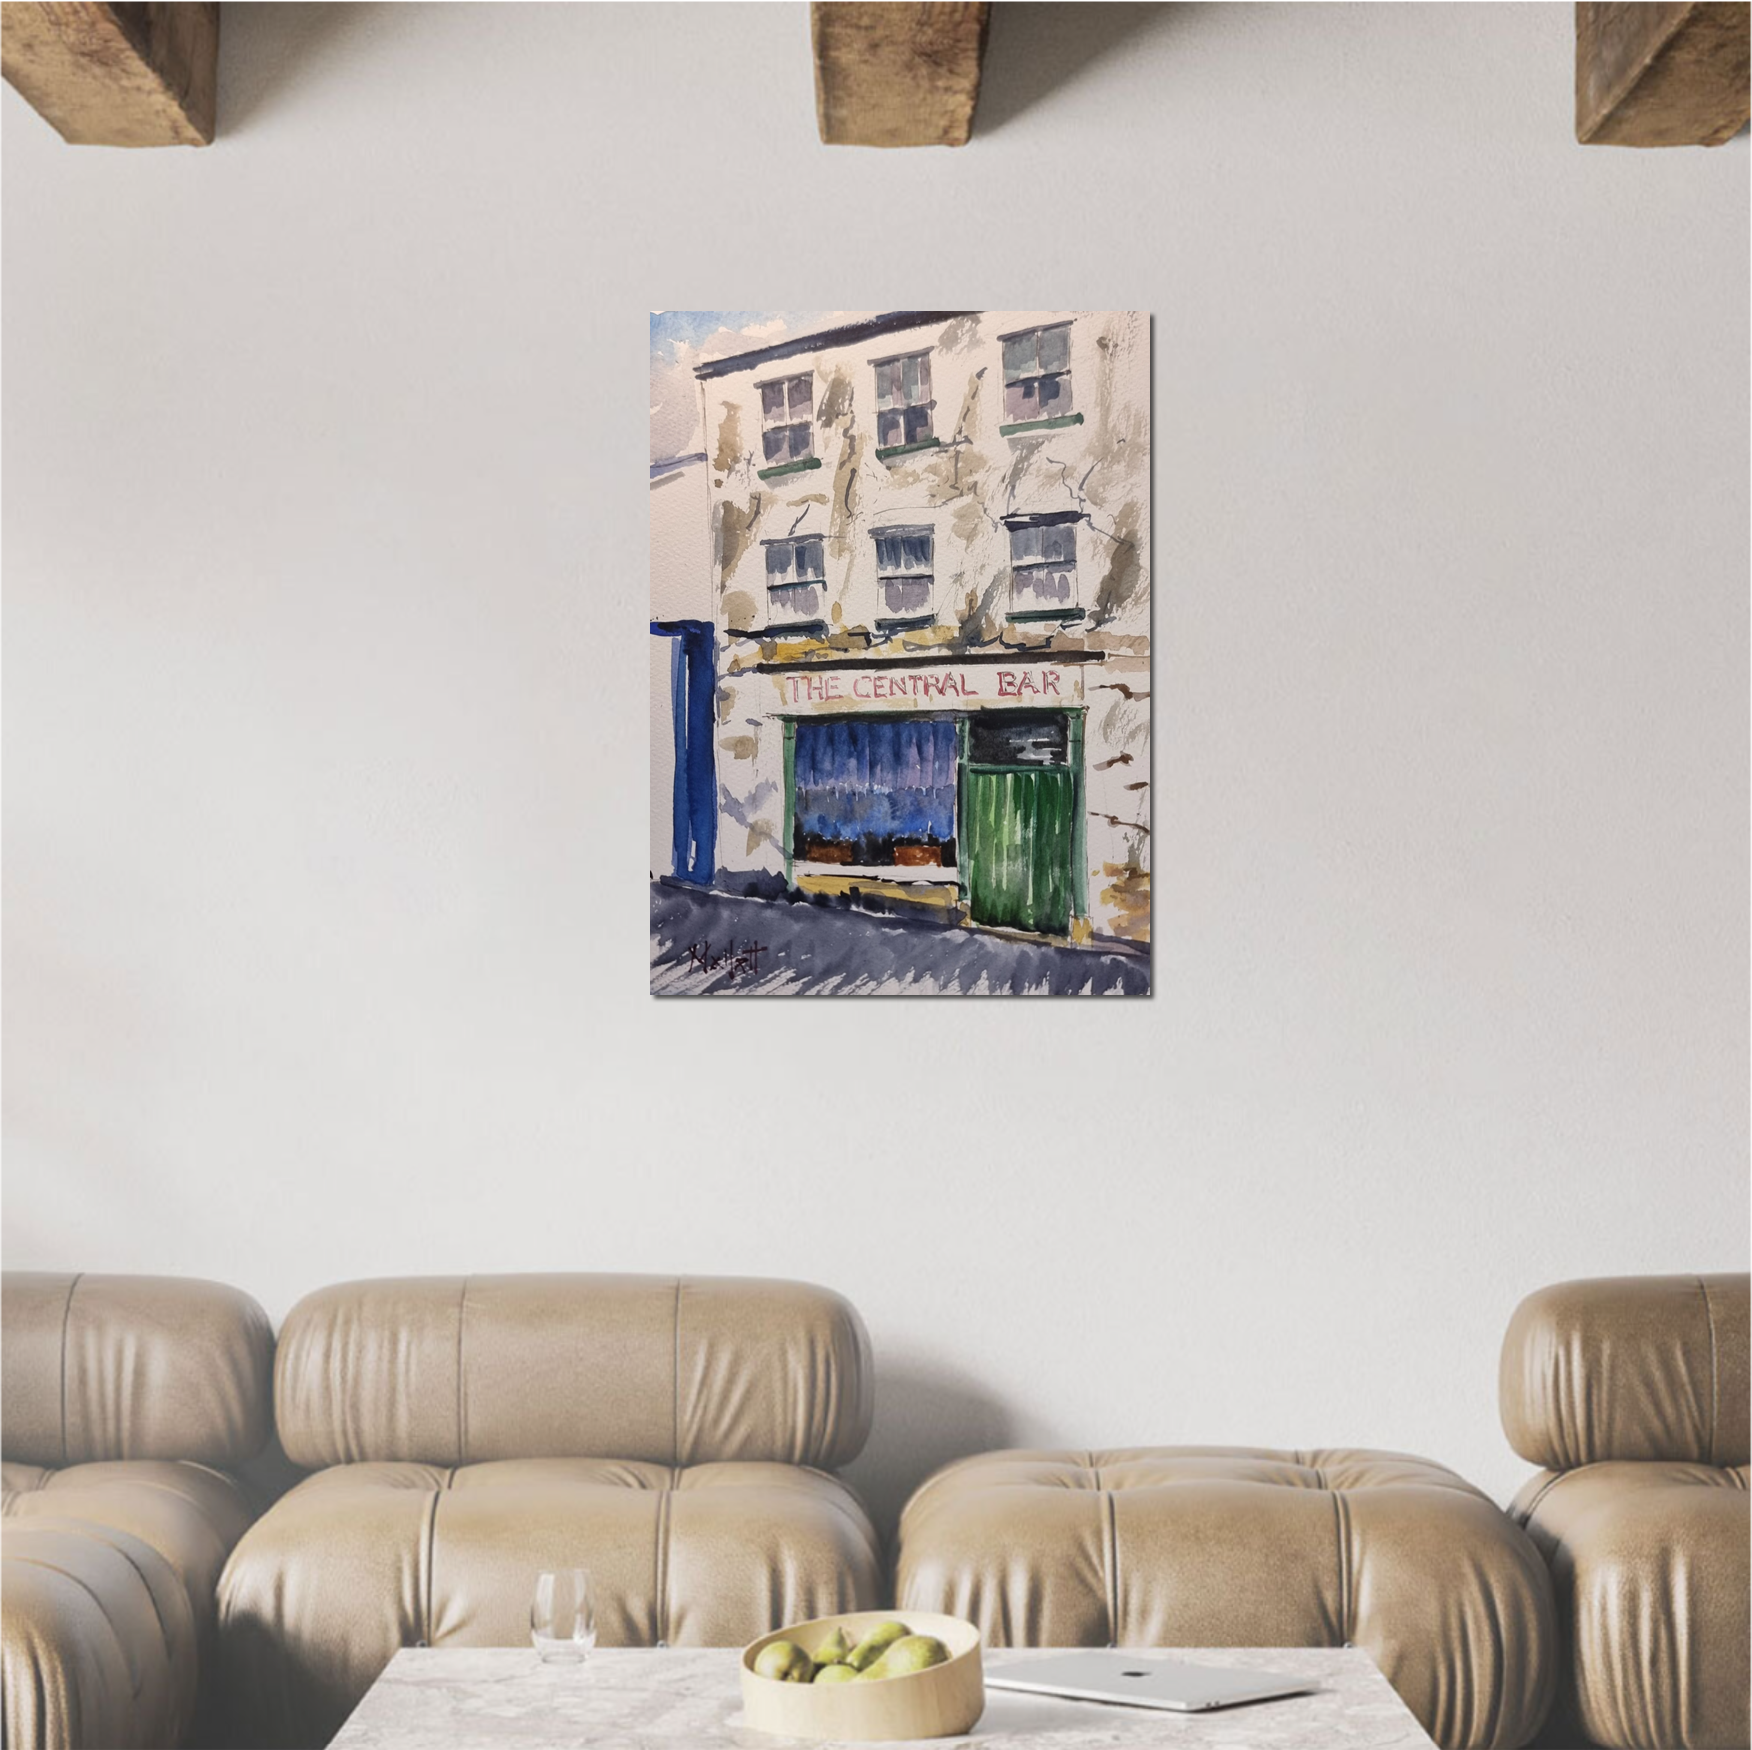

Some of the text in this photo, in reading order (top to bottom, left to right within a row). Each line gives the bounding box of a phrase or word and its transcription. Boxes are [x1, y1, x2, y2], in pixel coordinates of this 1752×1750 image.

[786, 670, 1061, 702] THE CENTRAL BAR
